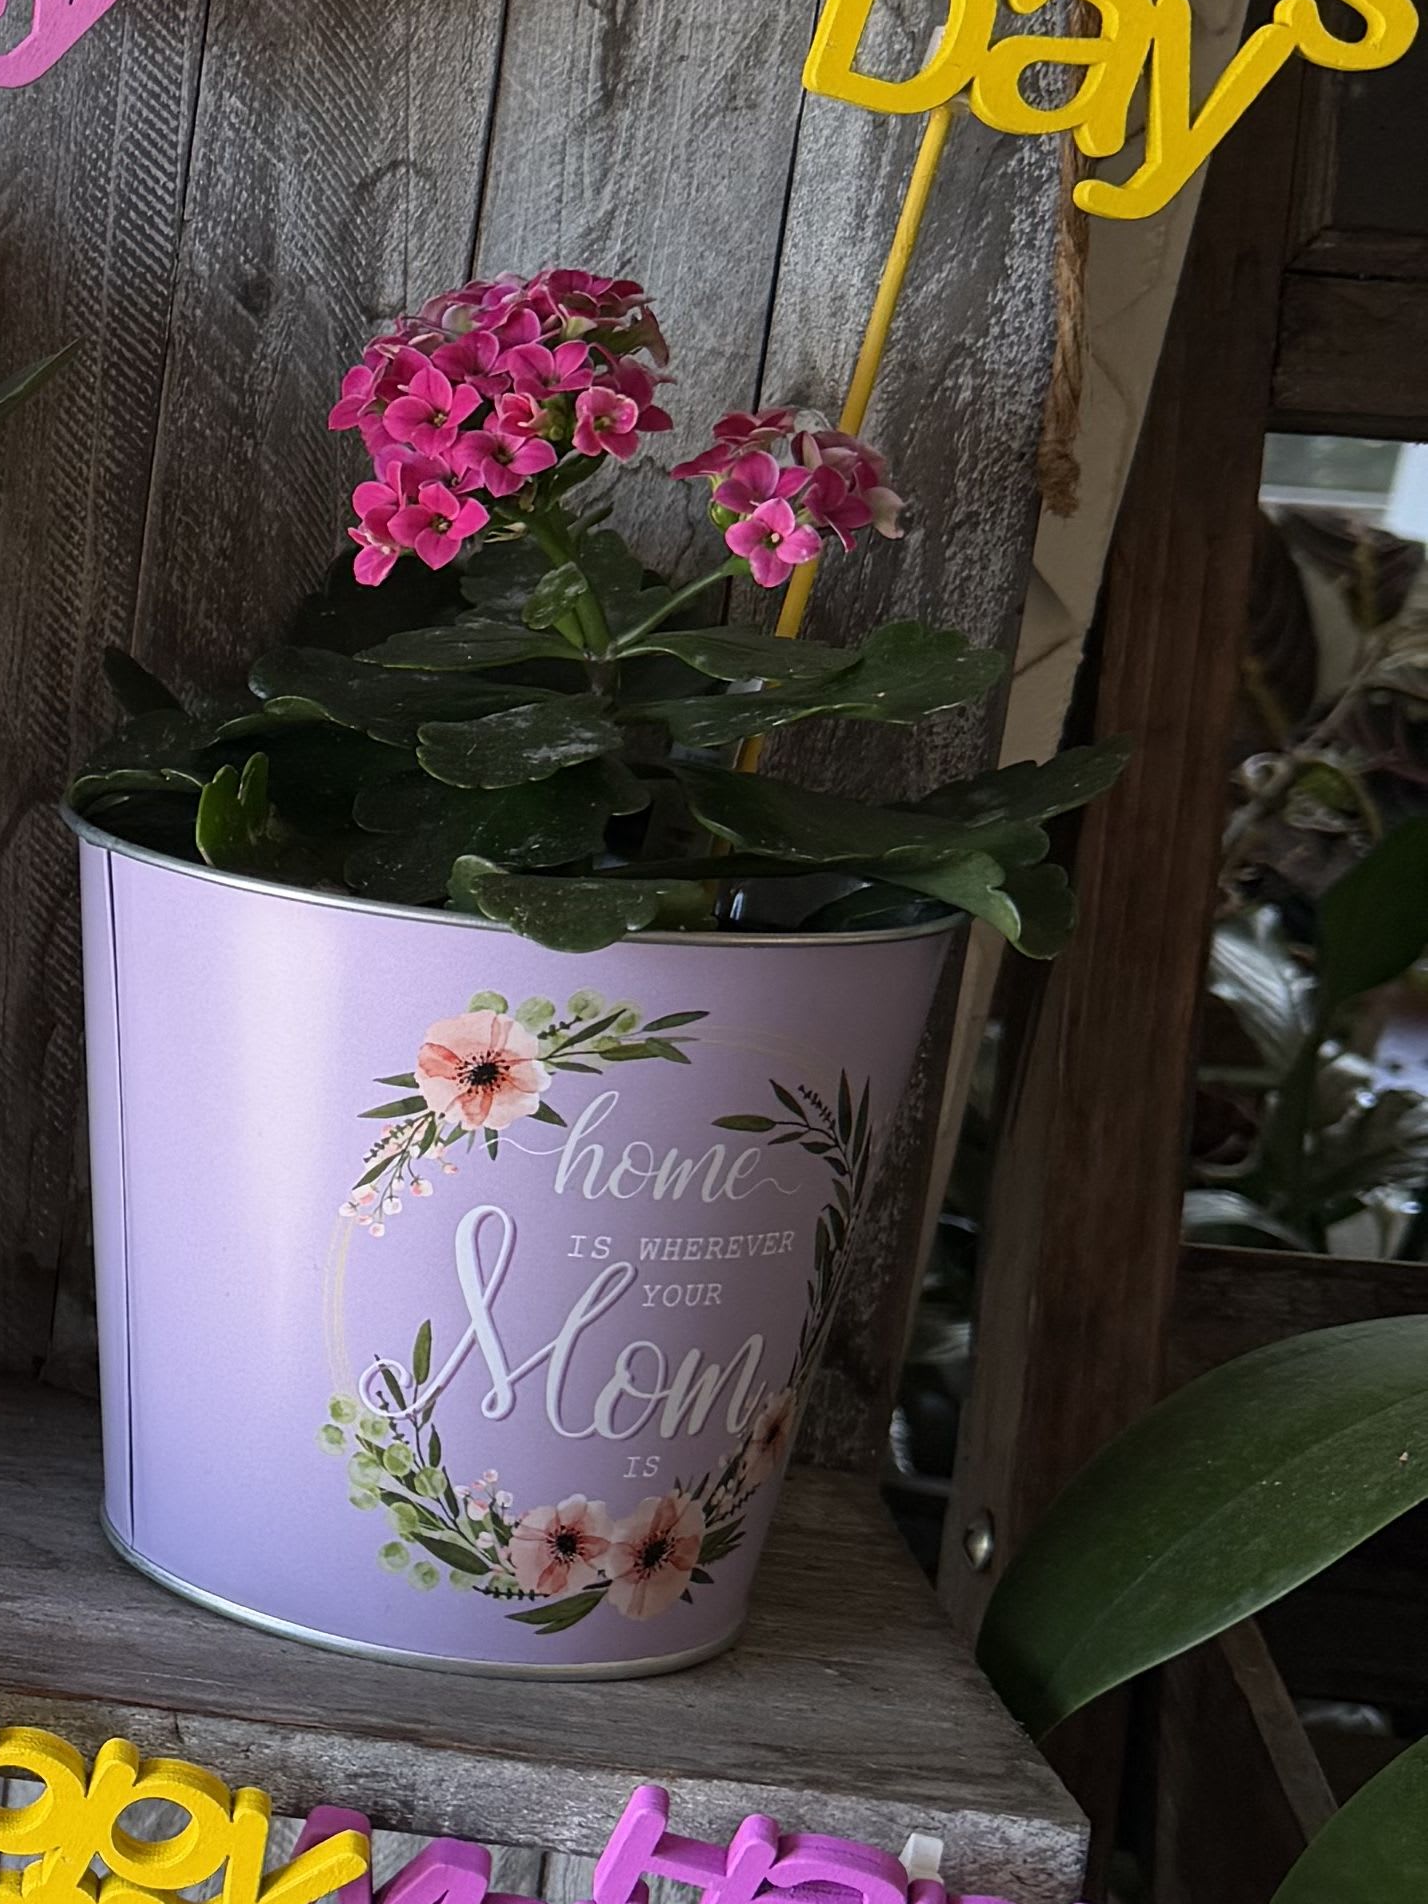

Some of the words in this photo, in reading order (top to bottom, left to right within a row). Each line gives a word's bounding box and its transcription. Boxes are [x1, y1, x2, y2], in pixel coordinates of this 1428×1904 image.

[479, 1090, 800, 1203] home
[568, 1234, 610, 1260] IS
[639, 1231, 796, 1261] WHEREVER
[642, 1283, 723, 1308] YOUR
[358, 1204, 774, 1441] Mom
[623, 1456, 660, 1478] IS
